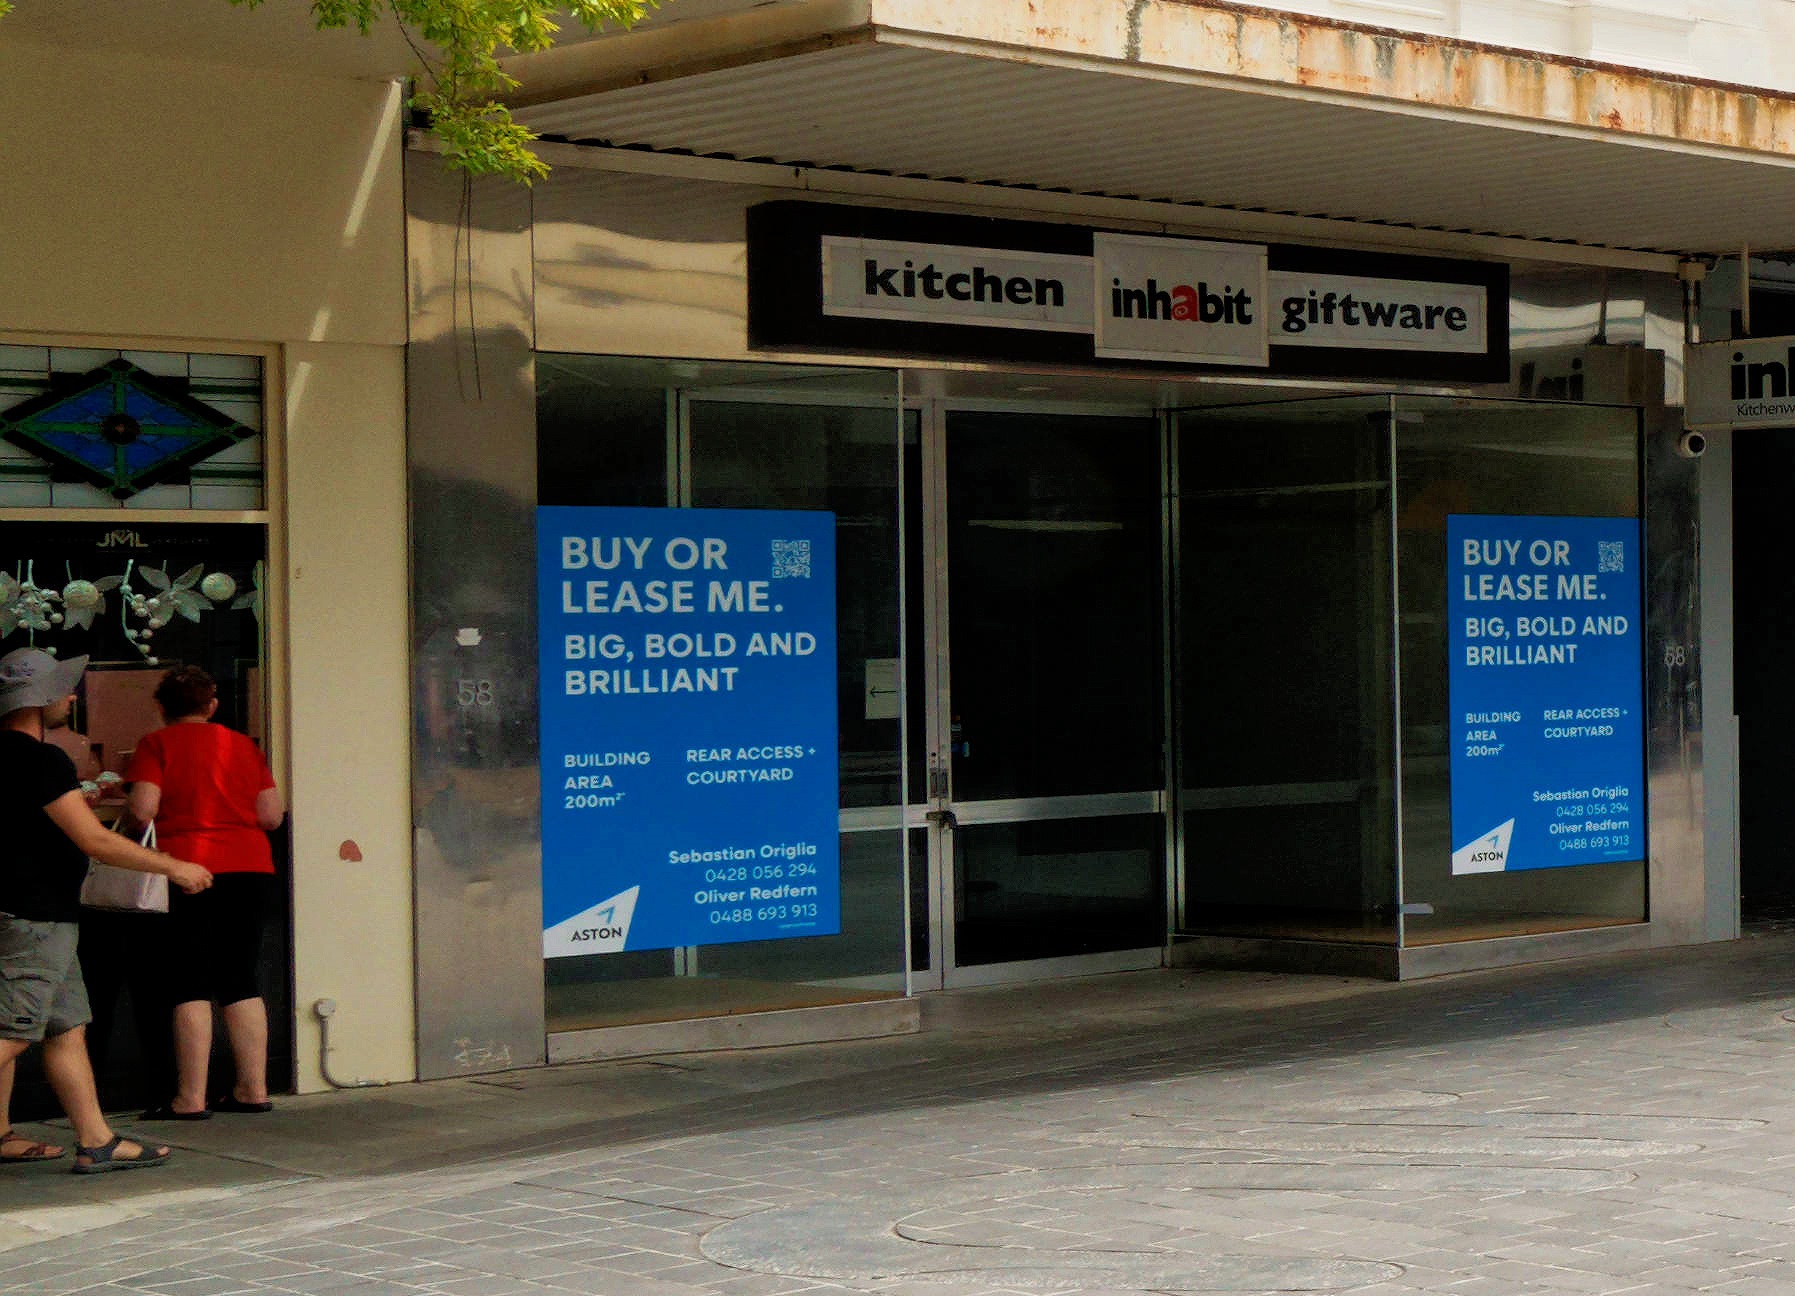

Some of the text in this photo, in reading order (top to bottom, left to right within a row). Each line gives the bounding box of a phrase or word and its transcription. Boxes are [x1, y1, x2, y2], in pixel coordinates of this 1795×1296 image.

[864, 258, 1469, 334] kitchen inhabit giftware
[562, 536, 728, 570] BUY OR
[1463, 539, 1570, 566] BUY OR
[1464, 574, 1607, 601] LEASE ME.
[562, 581, 784, 614] LEASE ME.
[1466, 615, 1629, 640] BIG, BOLD AND
[565, 631, 817, 663] BIG, BOLD AND
[1466, 644, 1578, 666] BRILLIANT
[565, 667, 739, 696] BRILLIANT
[458, 679, 492, 705] 58
[1465, 711, 1521, 724] BUILDING
[1543, 709, 1574, 721] REAR
[1575, 707, 1620, 720] ACCESS
[1466, 731, 1497, 742] AREA
[1543, 725, 1614, 739] COURTYARD
[564, 751, 651, 768] BUILDING
[686, 748, 733, 763] REAR
[736, 745, 804, 760] ACCESS
[564, 775, 614, 790] AREA
[686, 767, 794, 785] COURTYARD
[1532, 788, 1589, 802] Sebastian
[1556, 802, 1629, 817] 0428 056 294
[1550, 820, 1630, 834] Oliver Redfern
[1559, 834, 1630, 851] 0488 693 913
[668, 842, 817, 864] Sebastian Origlia
[1471, 852, 1504, 863] ASTON
[705, 862, 817, 883] 0428 056 294
[694, 884, 817, 905] Oliver Redfern
[710, 903, 818, 924] 0488 693 913
[570, 927, 623, 942] ASTON
